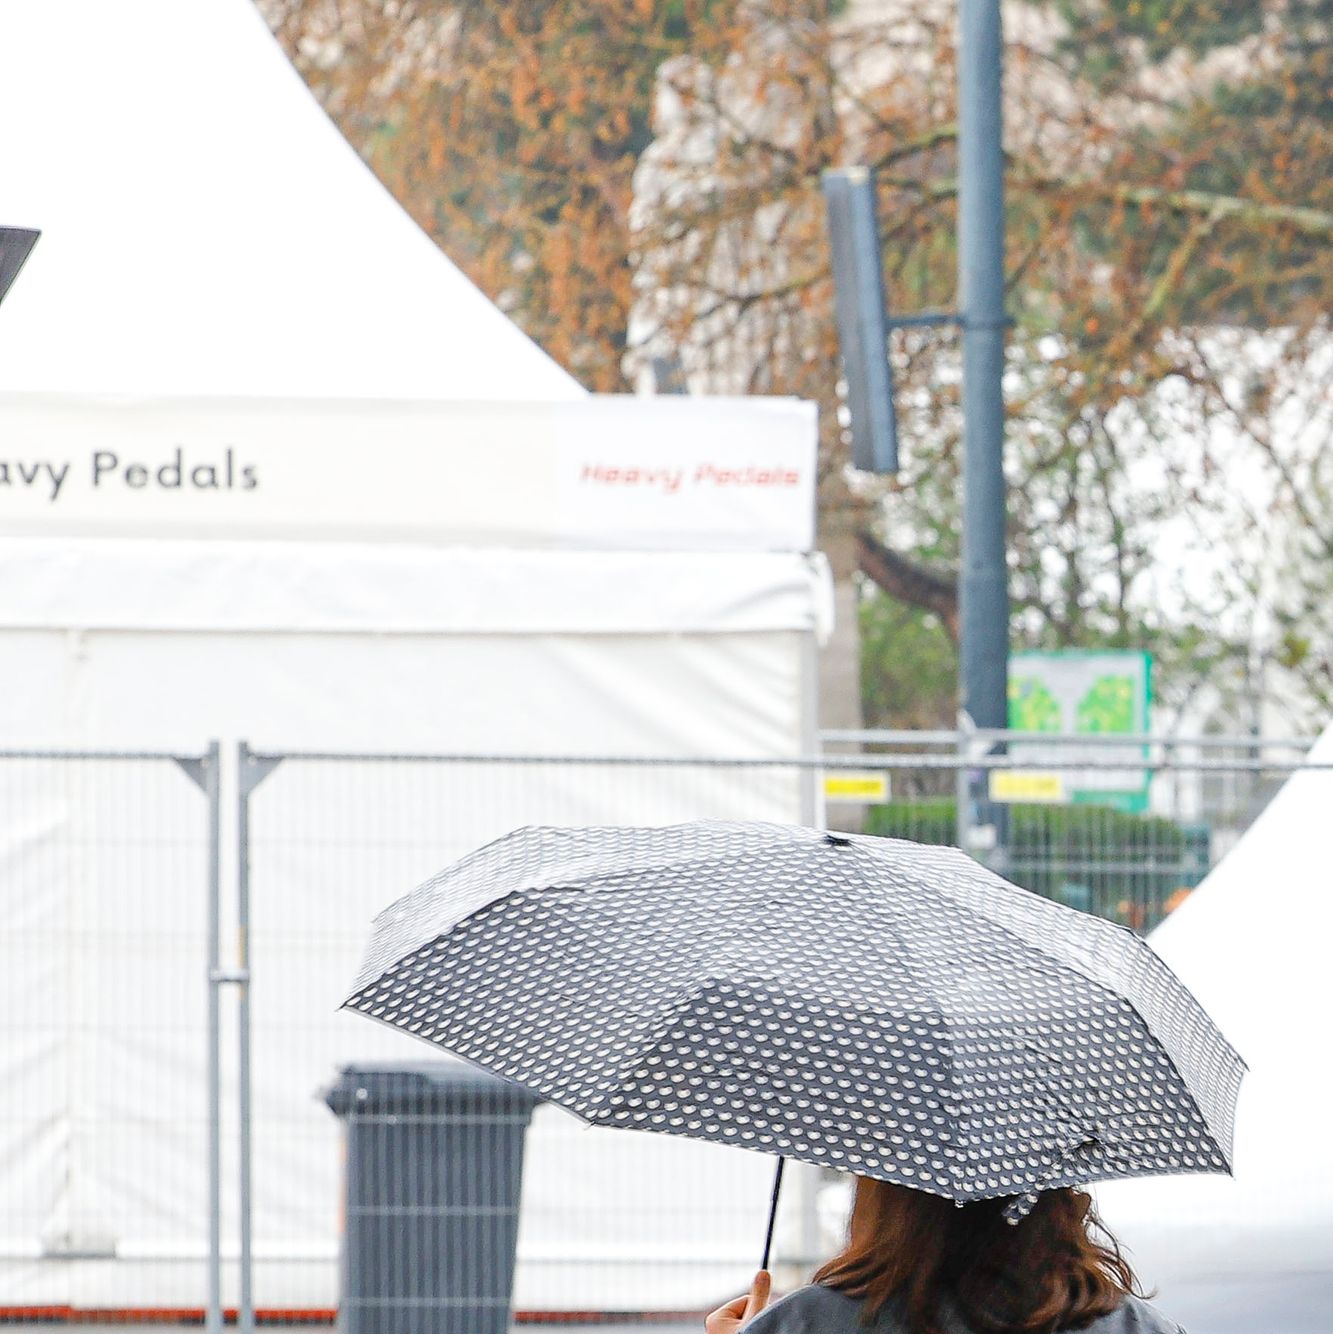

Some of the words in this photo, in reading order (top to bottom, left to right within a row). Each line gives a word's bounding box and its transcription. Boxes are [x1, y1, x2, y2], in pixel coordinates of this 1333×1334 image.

[92, 447, 258, 490] Pedals
[580, 462, 683, 494] Heavy
[693, 462, 800, 487] Pedals
